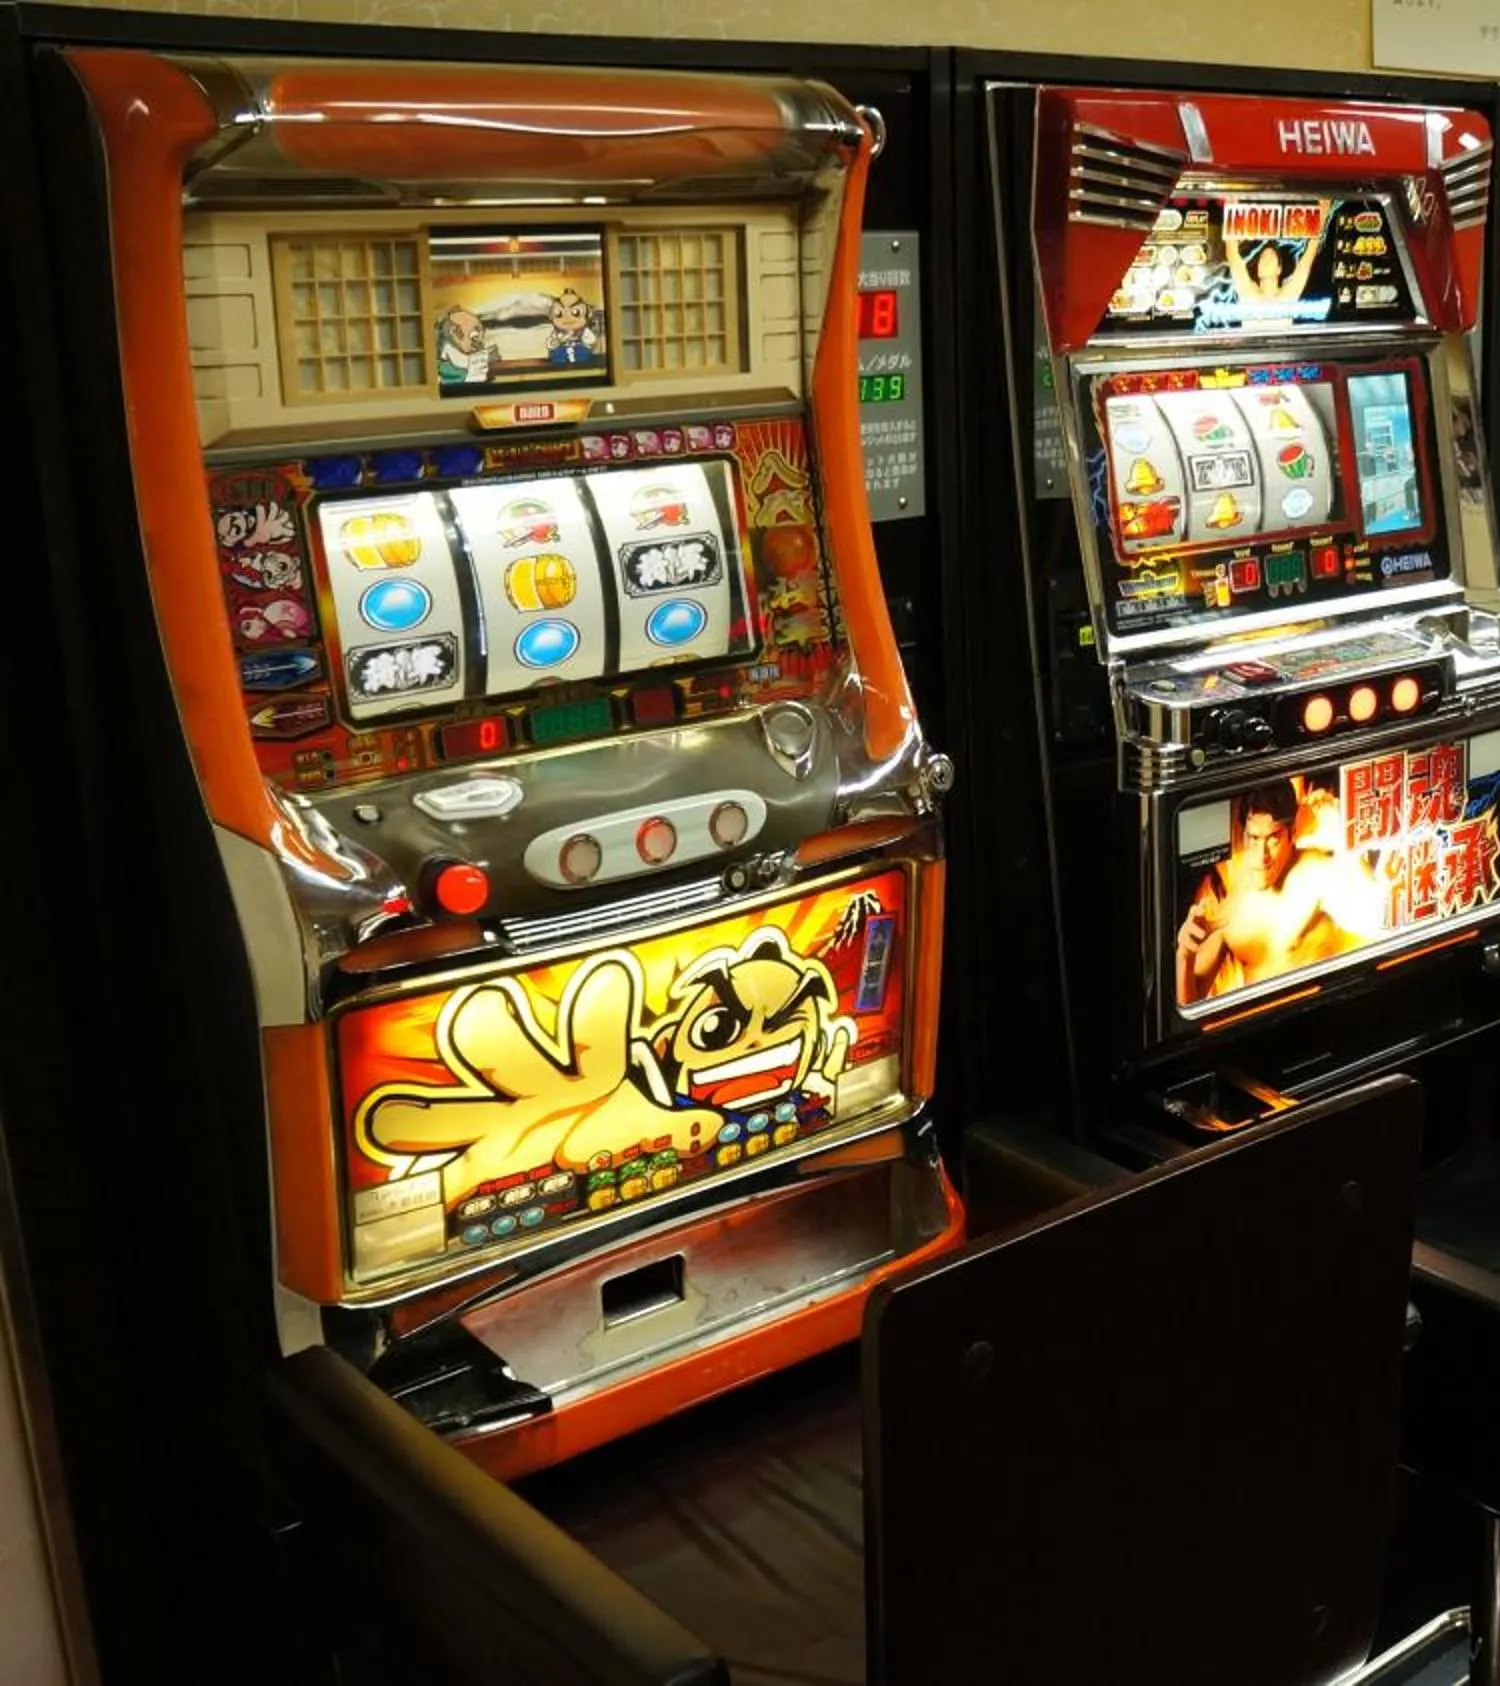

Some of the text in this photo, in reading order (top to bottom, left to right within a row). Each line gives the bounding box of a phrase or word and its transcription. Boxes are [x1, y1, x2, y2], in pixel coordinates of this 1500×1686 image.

[1278, 119, 1376, 155] HEIWA
[1225, 206, 1322, 238] INOKI ISM
[1393, 551, 1432, 571] HEIWA
[1346, 743, 1466, 849] 闘魂
